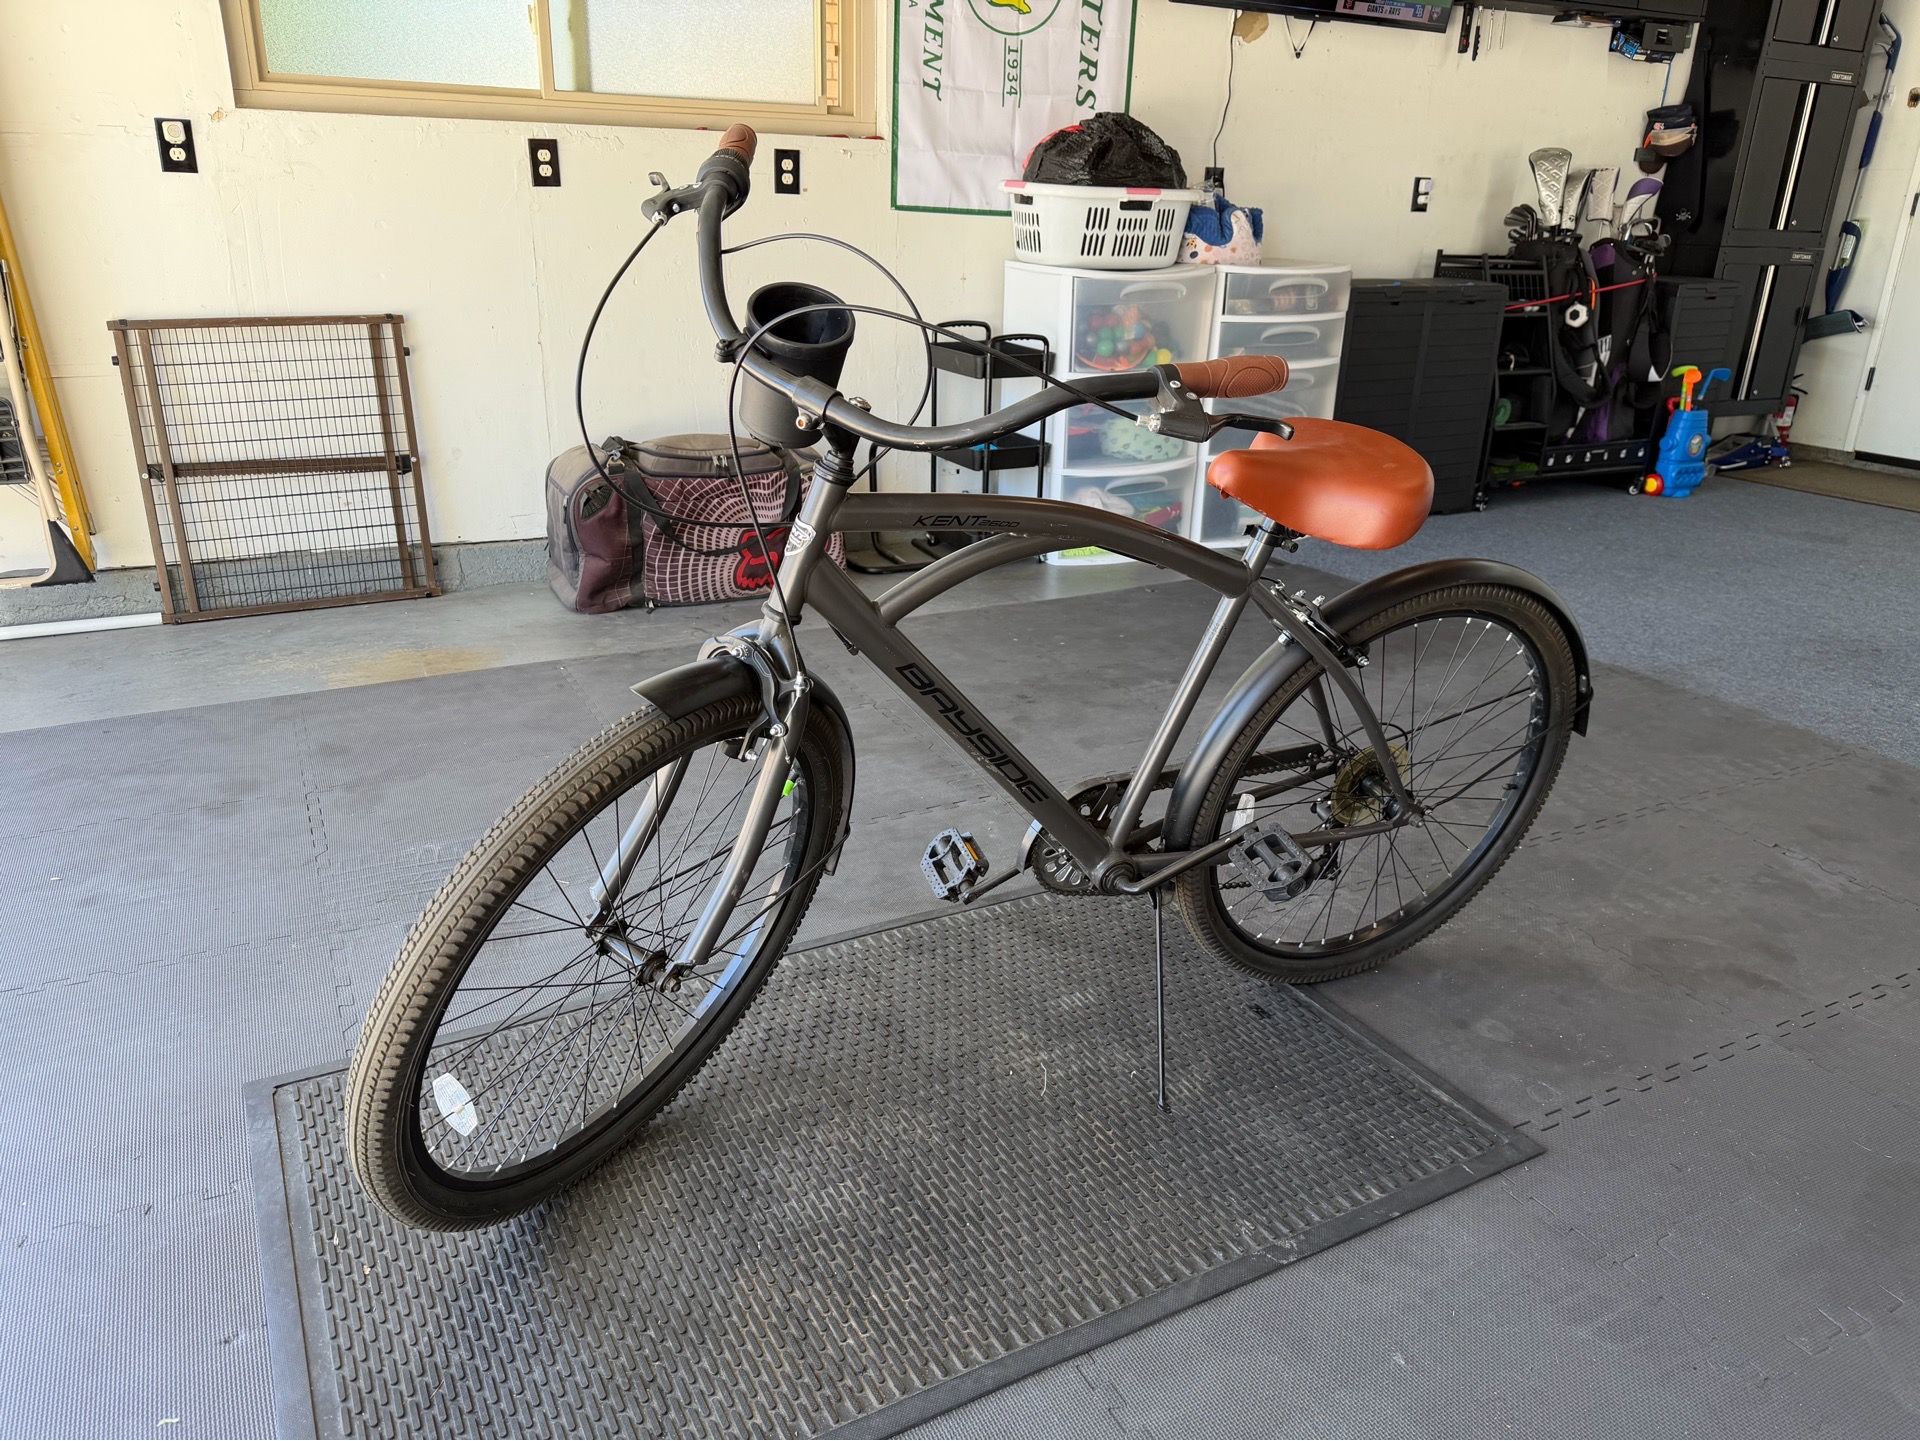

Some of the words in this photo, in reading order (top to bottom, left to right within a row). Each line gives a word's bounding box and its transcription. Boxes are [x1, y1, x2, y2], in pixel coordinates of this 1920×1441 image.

[1367, 4, 1384, 14] GIANTS
[922, 0, 945, 101] MENT
[1006, 45, 1019, 96] 1934
[1075, 0, 1104, 110] TERS
[912, 515, 987, 527] KENT
[895, 662, 1050, 803] BAYSIDE
